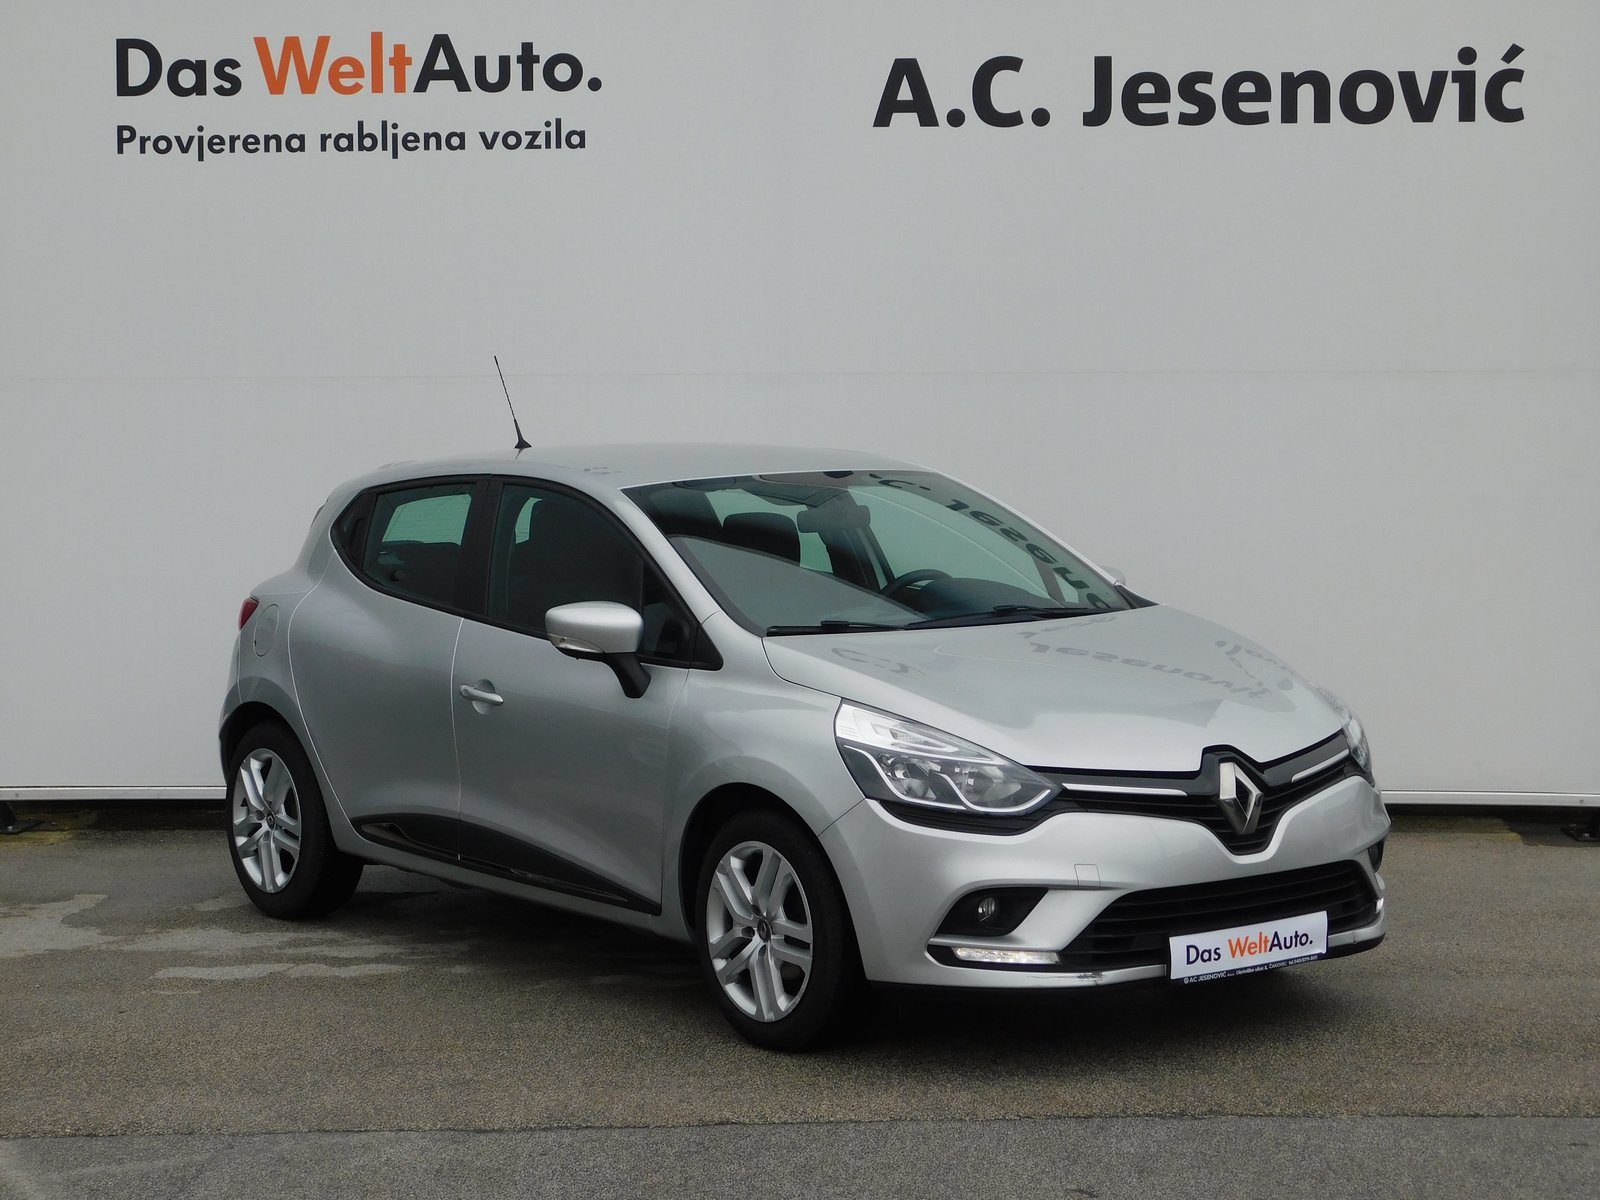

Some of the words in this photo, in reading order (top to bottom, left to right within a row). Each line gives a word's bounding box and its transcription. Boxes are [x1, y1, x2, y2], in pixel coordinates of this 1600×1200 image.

[115, 37, 243, 98] Das
[253, 31, 603, 97] WeltAuto.
[873, 56, 1051, 128] A.C.
[1082, 42, 1526, 128] Jesenović
[116, 124, 306, 162] Provjerena
[319, 119, 466, 160] rabljena
[478, 117, 586, 151] vozila
[1185, 944, 1222, 966] Das
[1227, 930, 1314, 959] WeltAuto.
